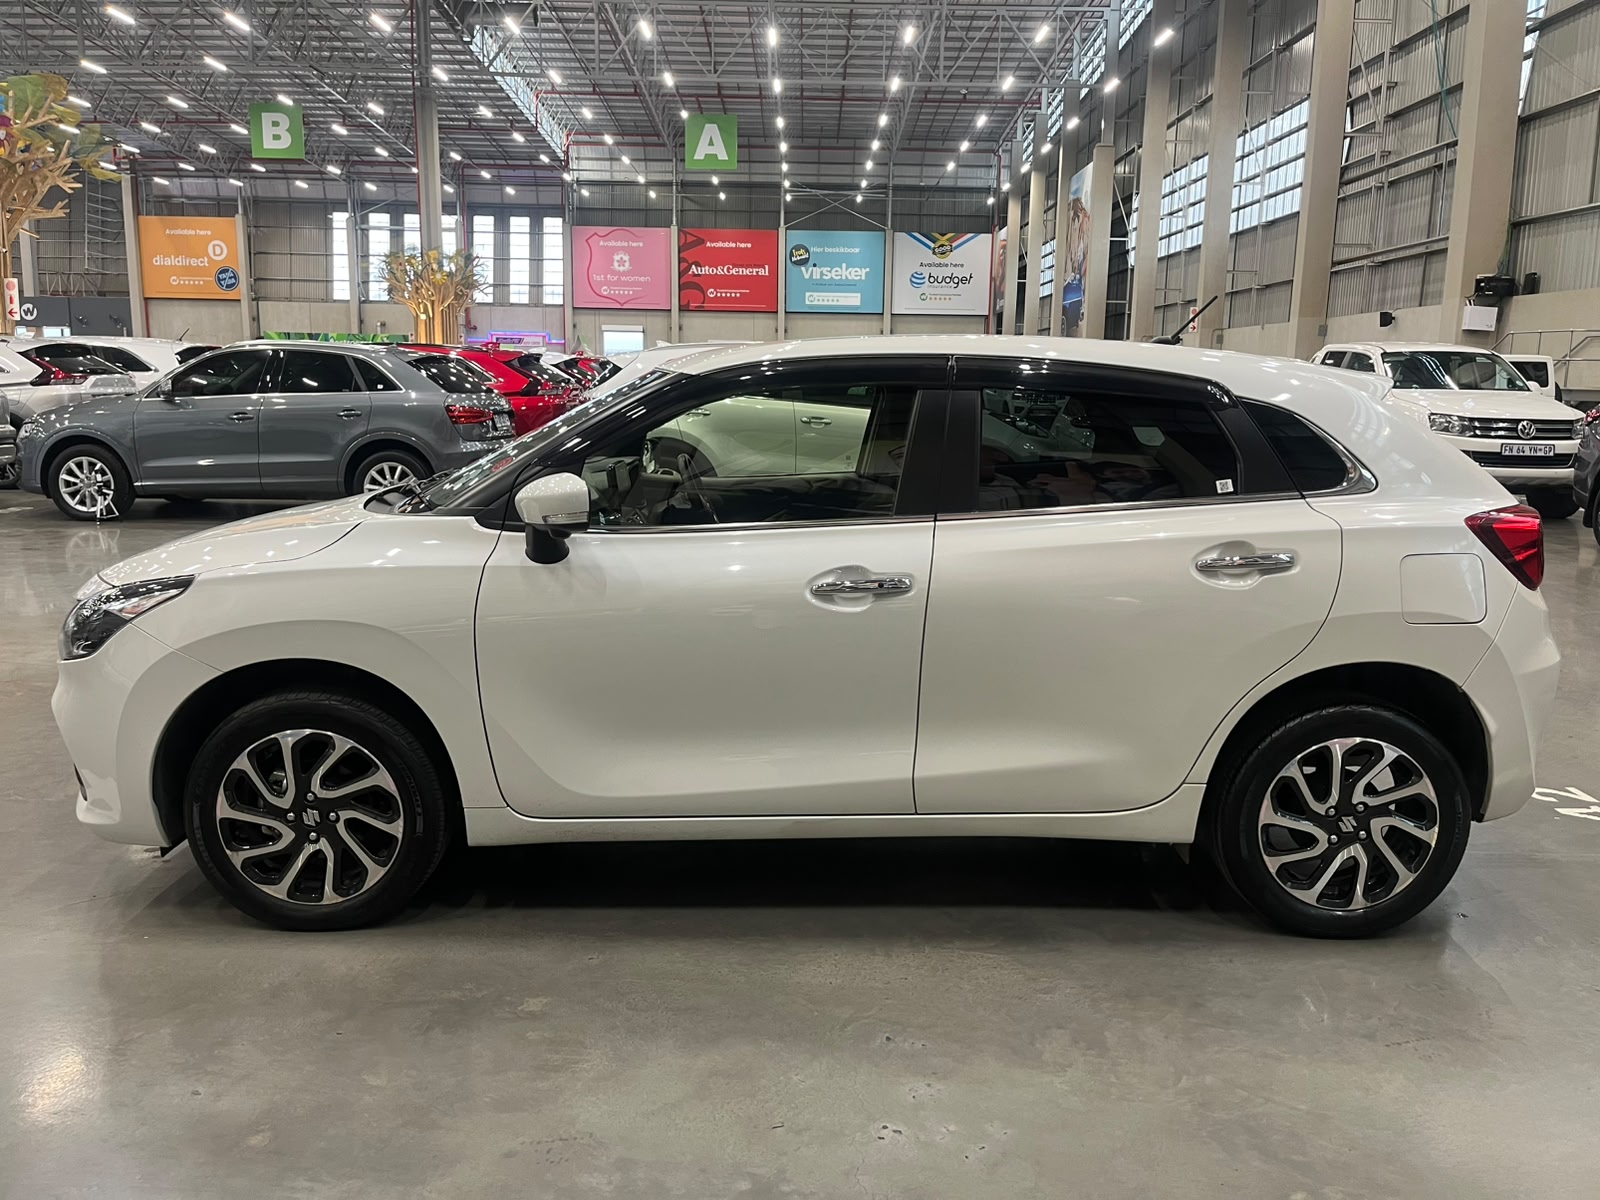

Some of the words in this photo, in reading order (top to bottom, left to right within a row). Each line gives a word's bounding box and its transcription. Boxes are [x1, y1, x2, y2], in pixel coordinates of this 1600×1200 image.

[261, 112, 292, 149] B
[693, 123, 729, 160] A
[152, 254, 209, 267] dialdirect
[688, 264, 769, 276] Auto&General
[800, 262, 870, 280] virseker
[927, 272, 974, 289] budget
[21, 303, 38, 319] W
[1503, 445, 1513, 454] FN
[1516, 445, 1525, 454] 64
[1528, 446, 1538, 454] YN
[1543, 446, 1553, 455] GP
